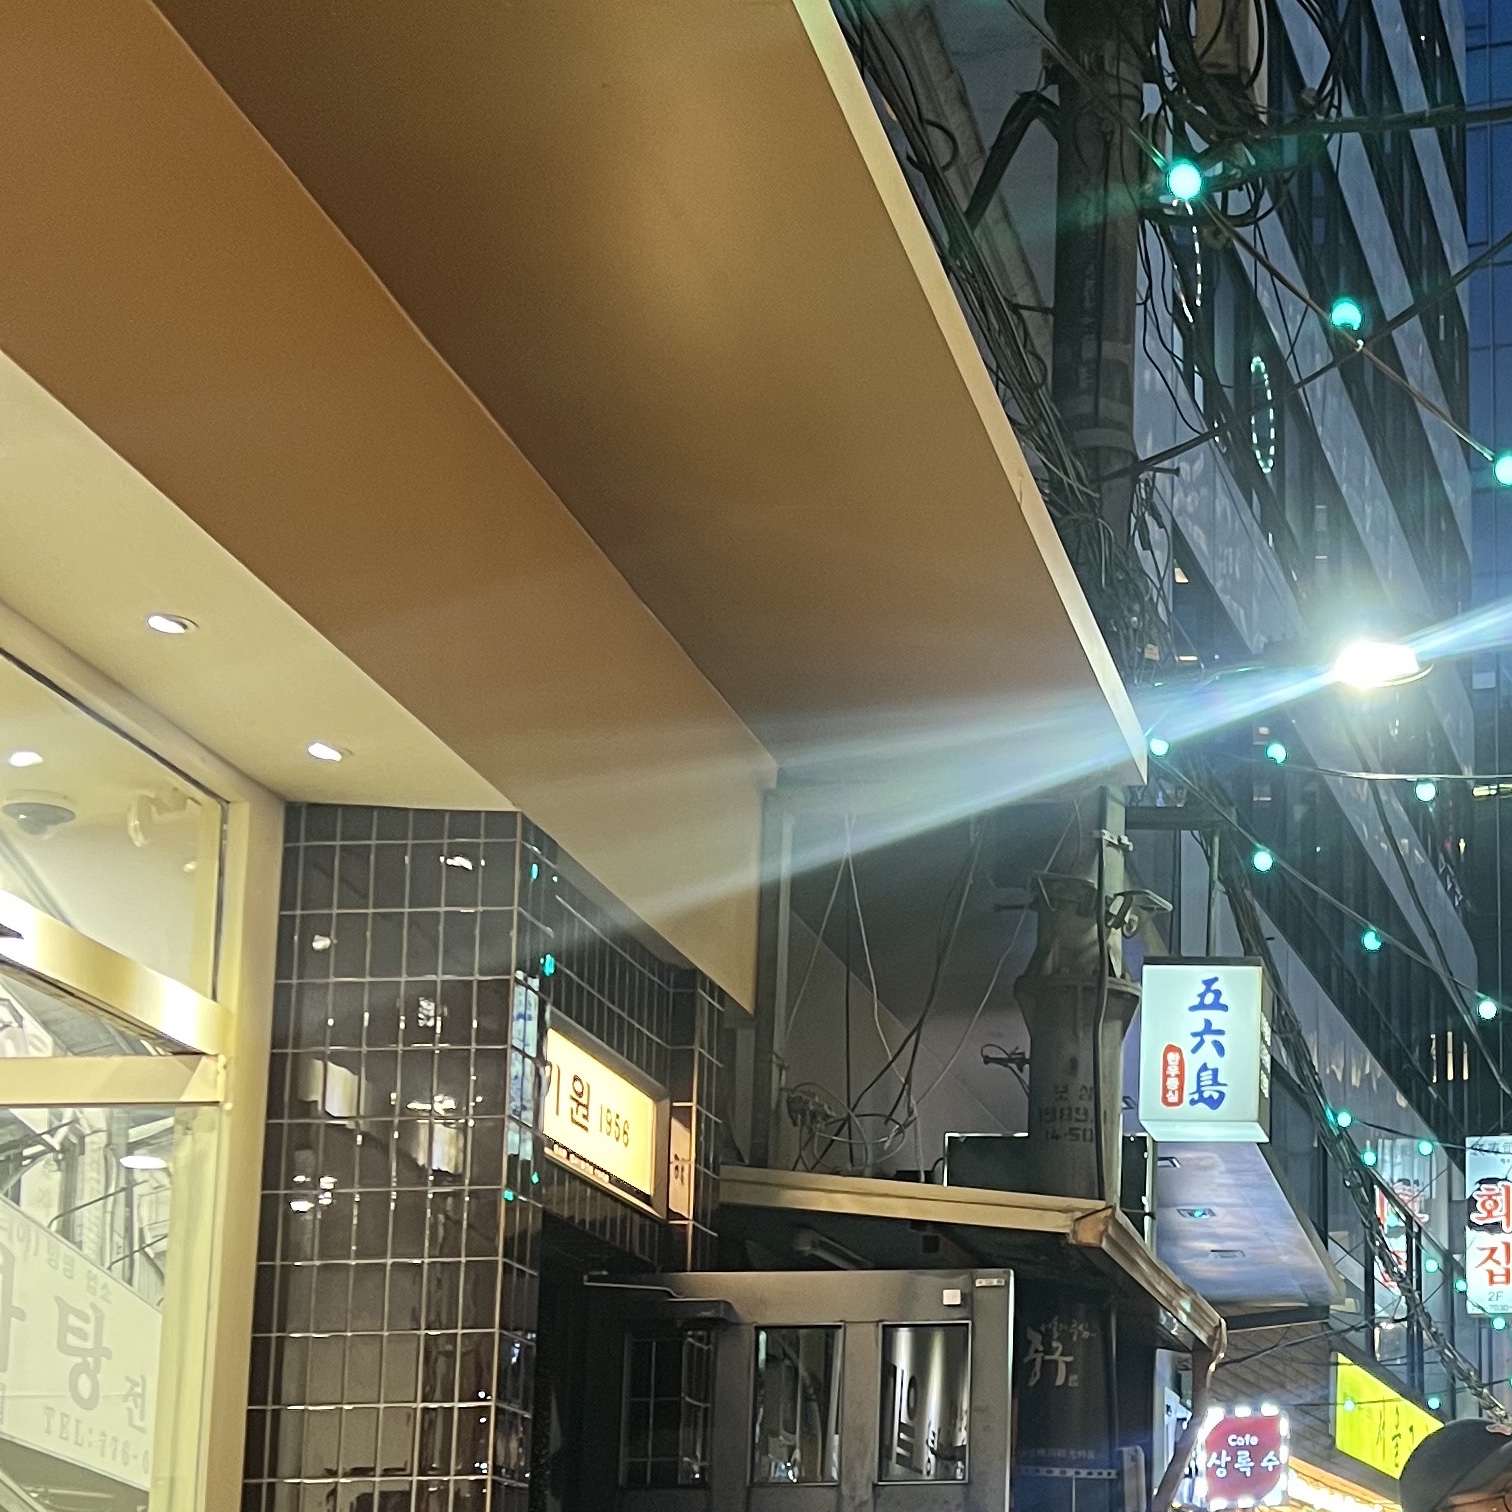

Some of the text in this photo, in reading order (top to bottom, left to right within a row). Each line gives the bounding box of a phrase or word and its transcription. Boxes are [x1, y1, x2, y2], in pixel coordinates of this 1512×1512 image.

[1188, 977, 1229, 1110] 五六島
[599, 1102, 630, 1148] 1956
[1487, 1291, 1504, 1302] 2F
[1227, 1433, 1259, 1447] Cafe
[1206, 1449, 1281, 1478] 상록수
